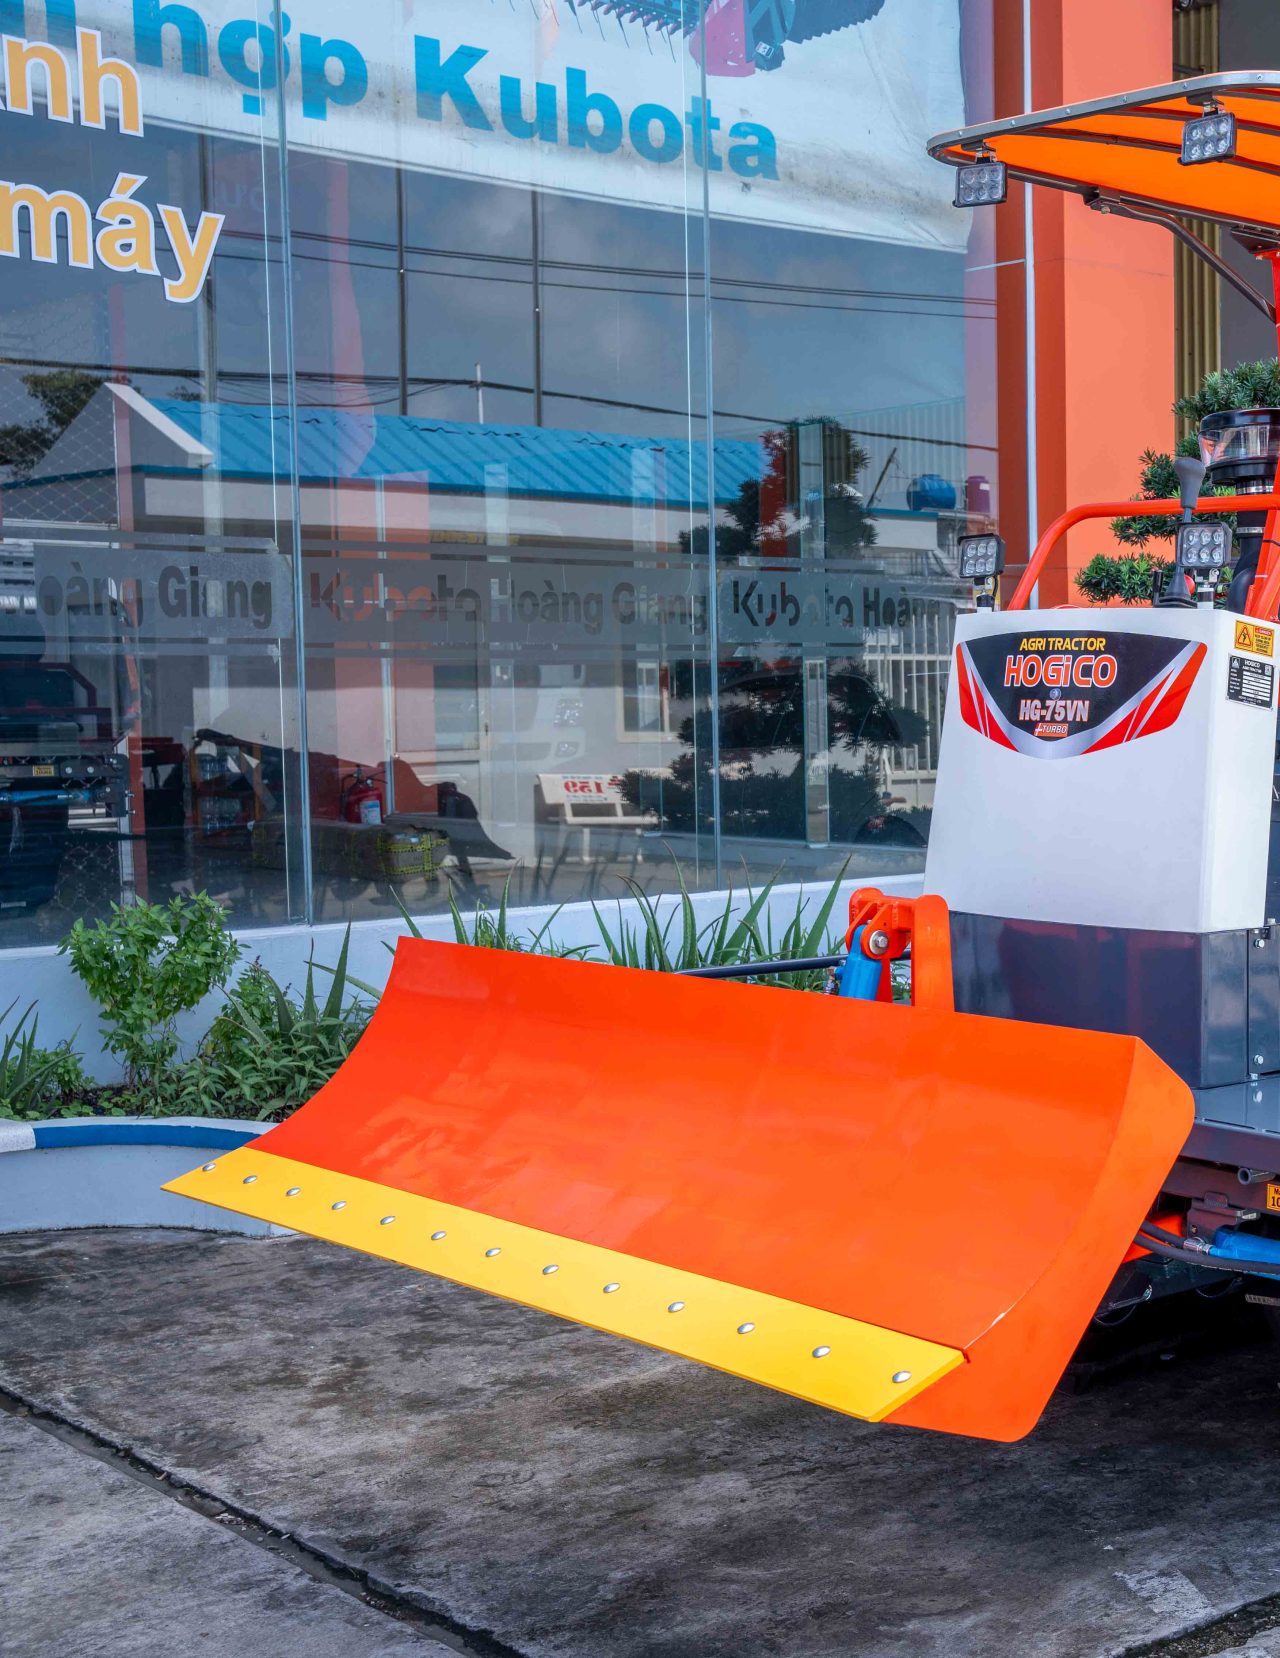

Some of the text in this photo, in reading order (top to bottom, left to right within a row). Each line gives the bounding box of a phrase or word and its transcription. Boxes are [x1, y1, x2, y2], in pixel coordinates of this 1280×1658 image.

[413, 33, 779, 182] Kubota
[0, 172, 225, 303] máy
[158, 564, 273, 631] Giang
[489, 577, 604, 636] Hoàng
[1019, 637, 1106, 652] AGRI TRACTOR
[1018, 699, 1090, 723] HG-75VN
